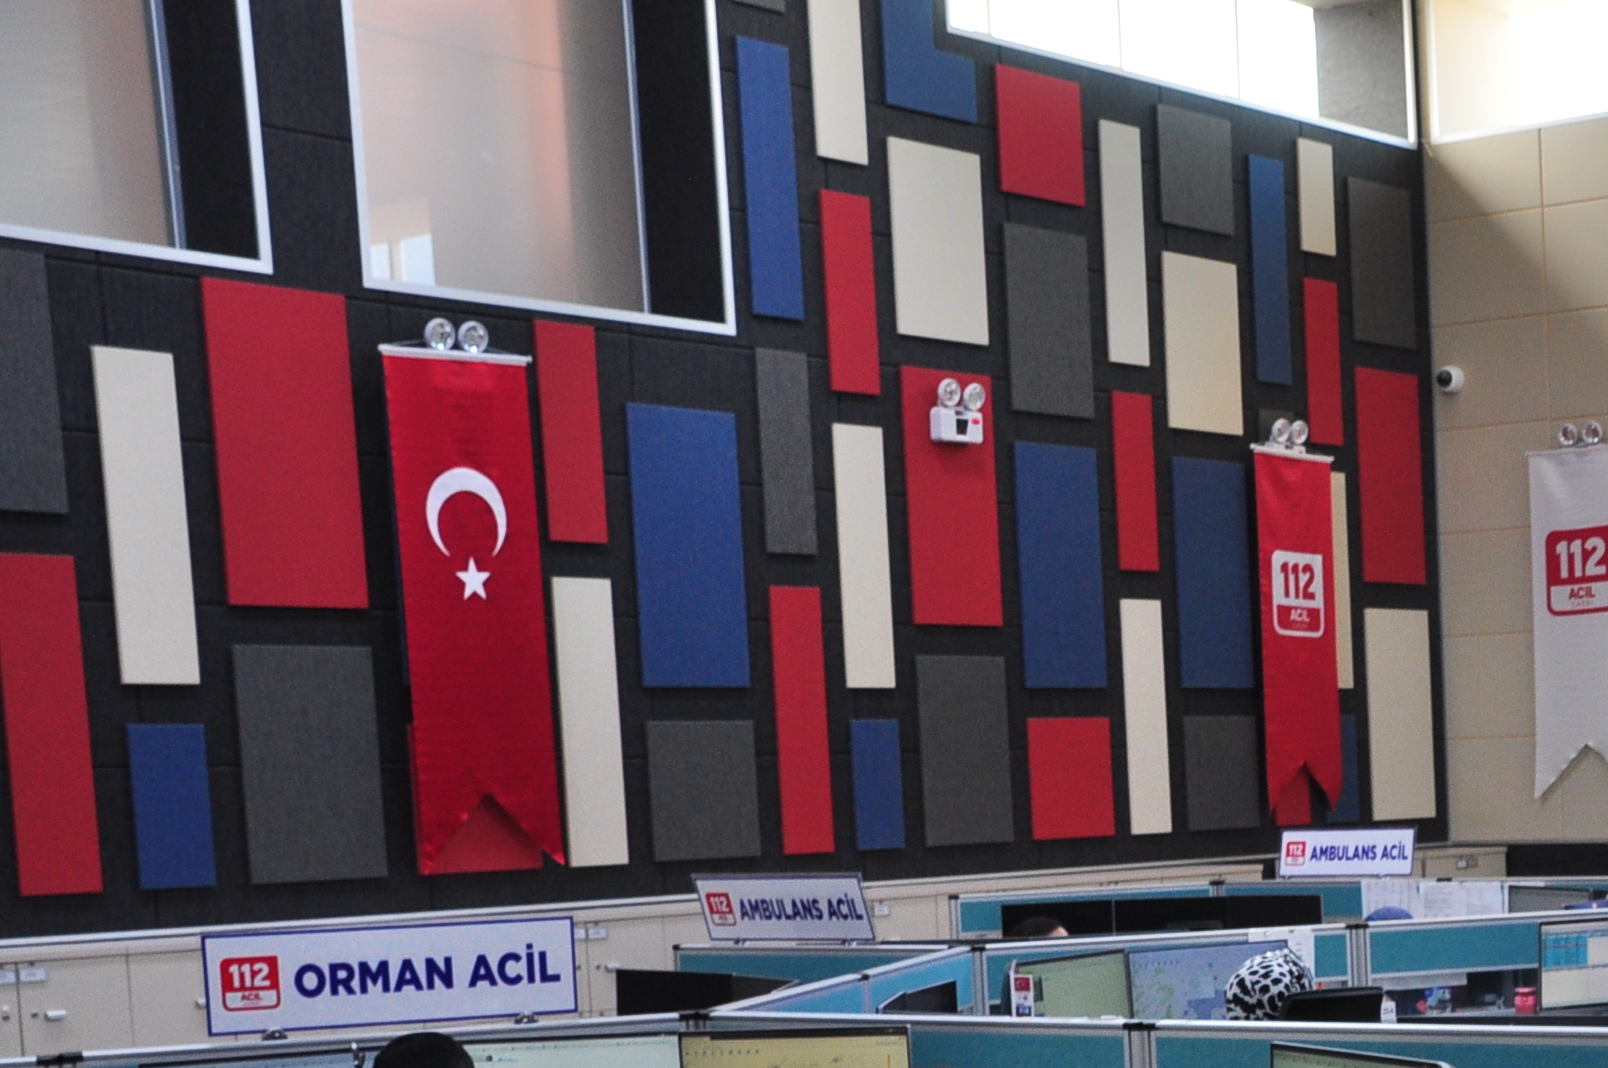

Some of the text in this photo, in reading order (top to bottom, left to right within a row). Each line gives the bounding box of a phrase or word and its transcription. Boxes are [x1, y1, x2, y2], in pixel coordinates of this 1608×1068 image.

[1556, 536, 1607, 579] 112
[1280, 562, 1316, 601] 112
[1310, 845, 1377, 861] AMBULANS
[1380, 840, 1408, 860] ACİL
[709, 892, 864, 921] 112 AMBULANS ACİL
[229, 943, 562, 998] 112 ORMAN ACİL
